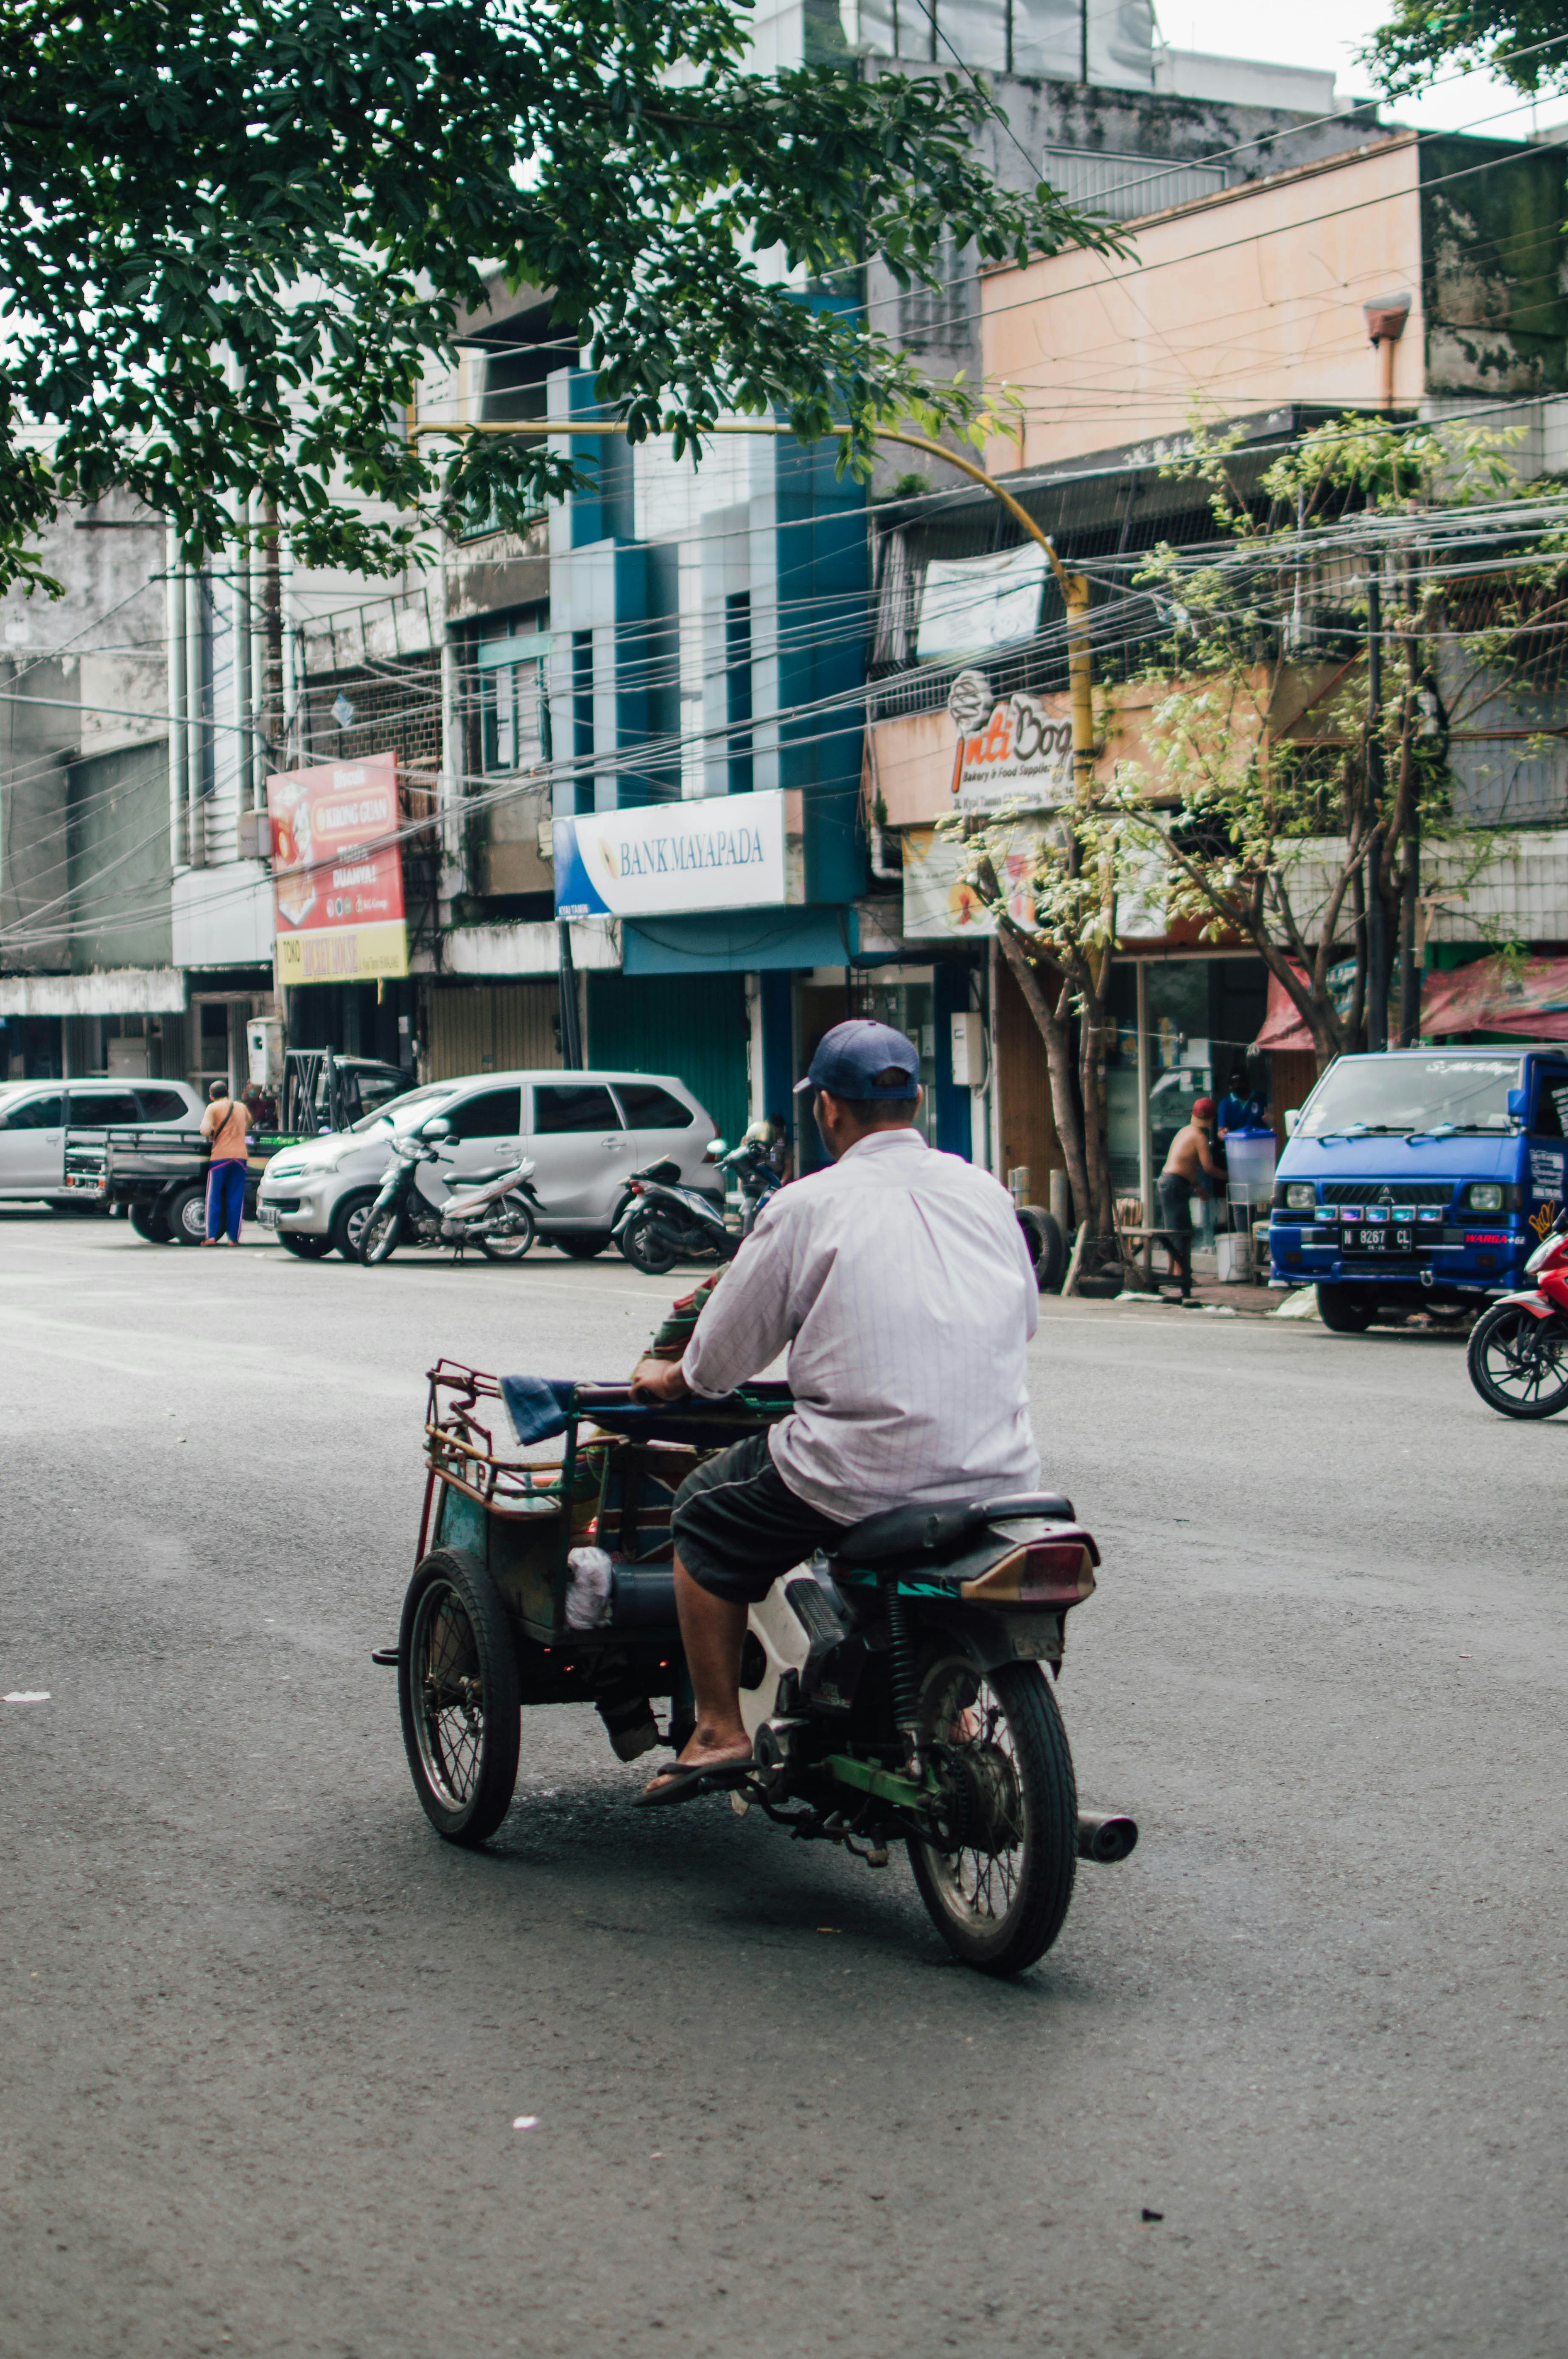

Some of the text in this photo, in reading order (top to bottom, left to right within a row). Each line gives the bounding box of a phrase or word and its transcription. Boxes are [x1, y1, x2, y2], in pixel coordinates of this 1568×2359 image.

[1014, 699, 1072, 780] Bog
[963, 771, 989, 783] Bakery
[998, 766, 1017, 778] Food
[325, 797, 387, 830] KHONG GUAN
[619, 826, 764, 876] BANK MAYAPADA
[283, 939, 300, 964] TOKO
[1344, 1230, 1410, 1244] N 8267 CL
